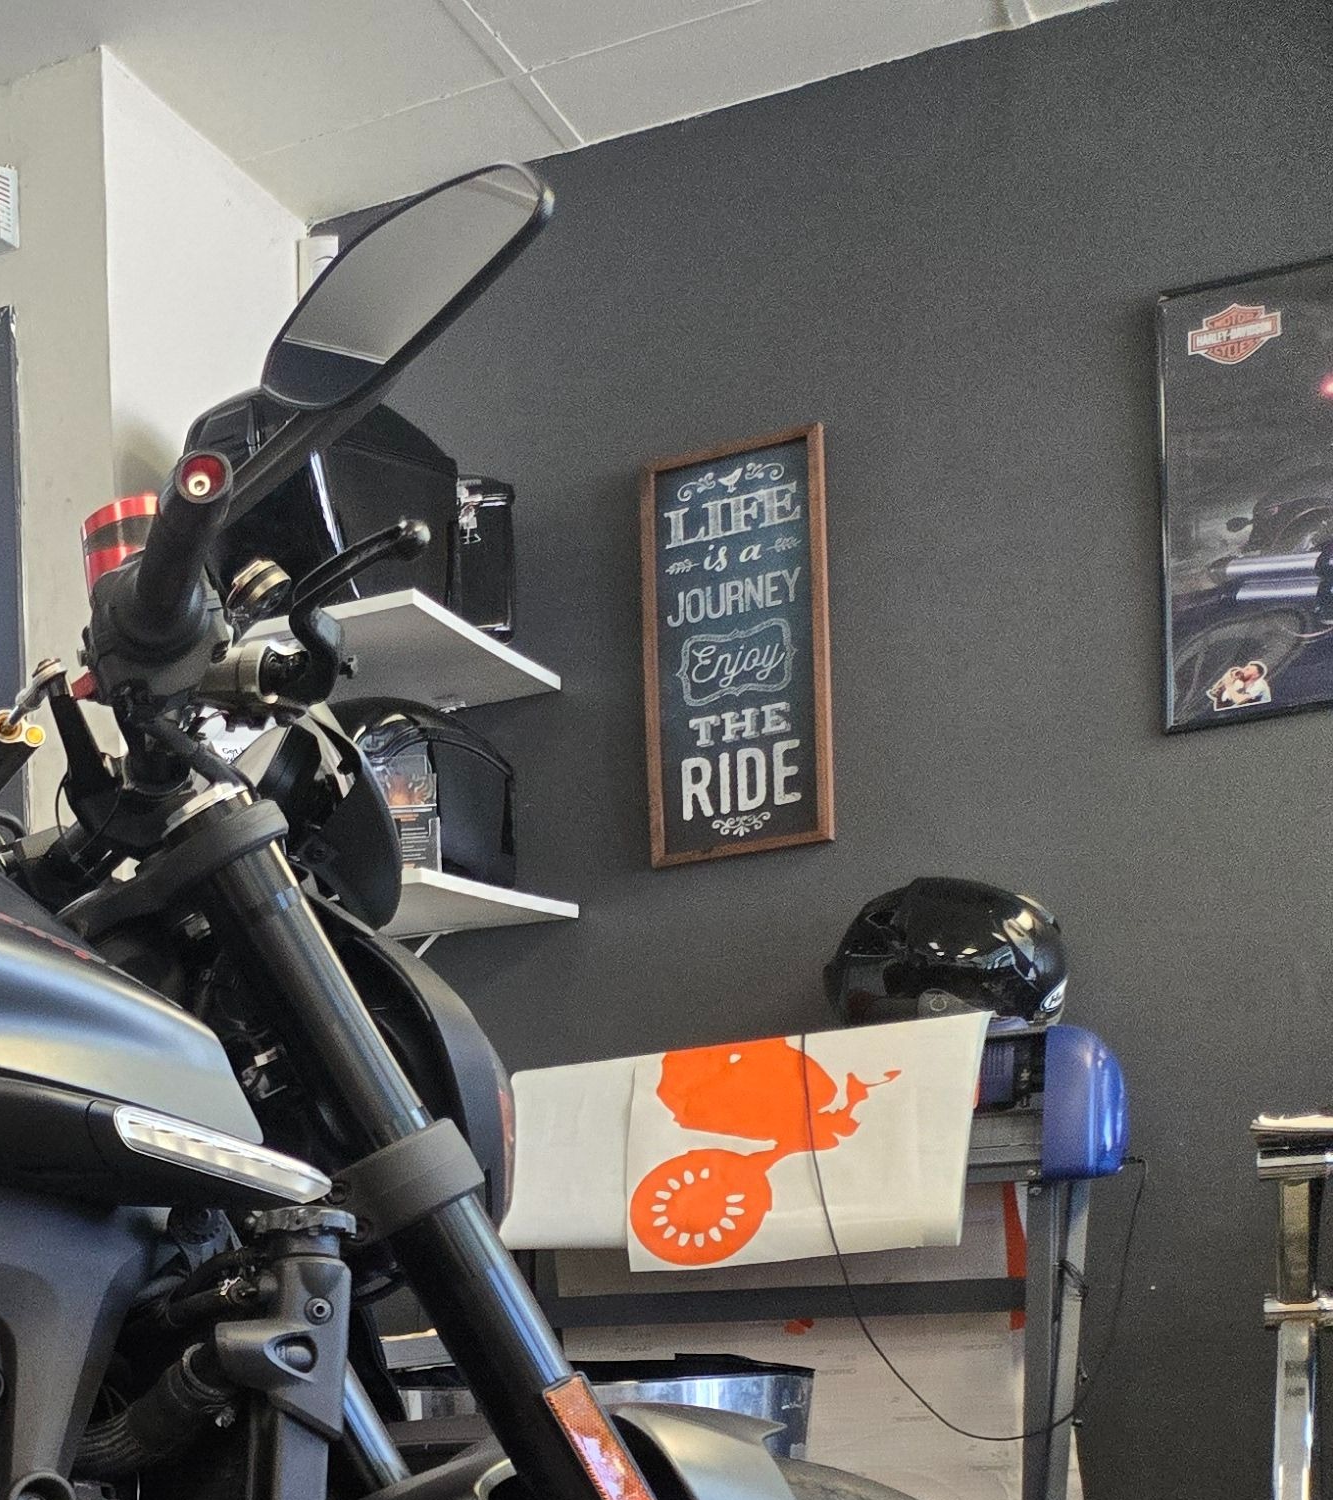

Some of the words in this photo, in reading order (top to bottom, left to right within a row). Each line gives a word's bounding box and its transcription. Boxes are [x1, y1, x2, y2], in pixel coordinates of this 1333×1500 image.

[664, 481, 801, 549] LIFE
[704, 545, 727, 572] is
[739, 543, 762, 562] a
[666, 567, 801, 627] JOURNEY
[691, 643, 785, 688] Enjoy
[689, 701, 791, 747] THE
[681, 738, 801, 821] RIDE
